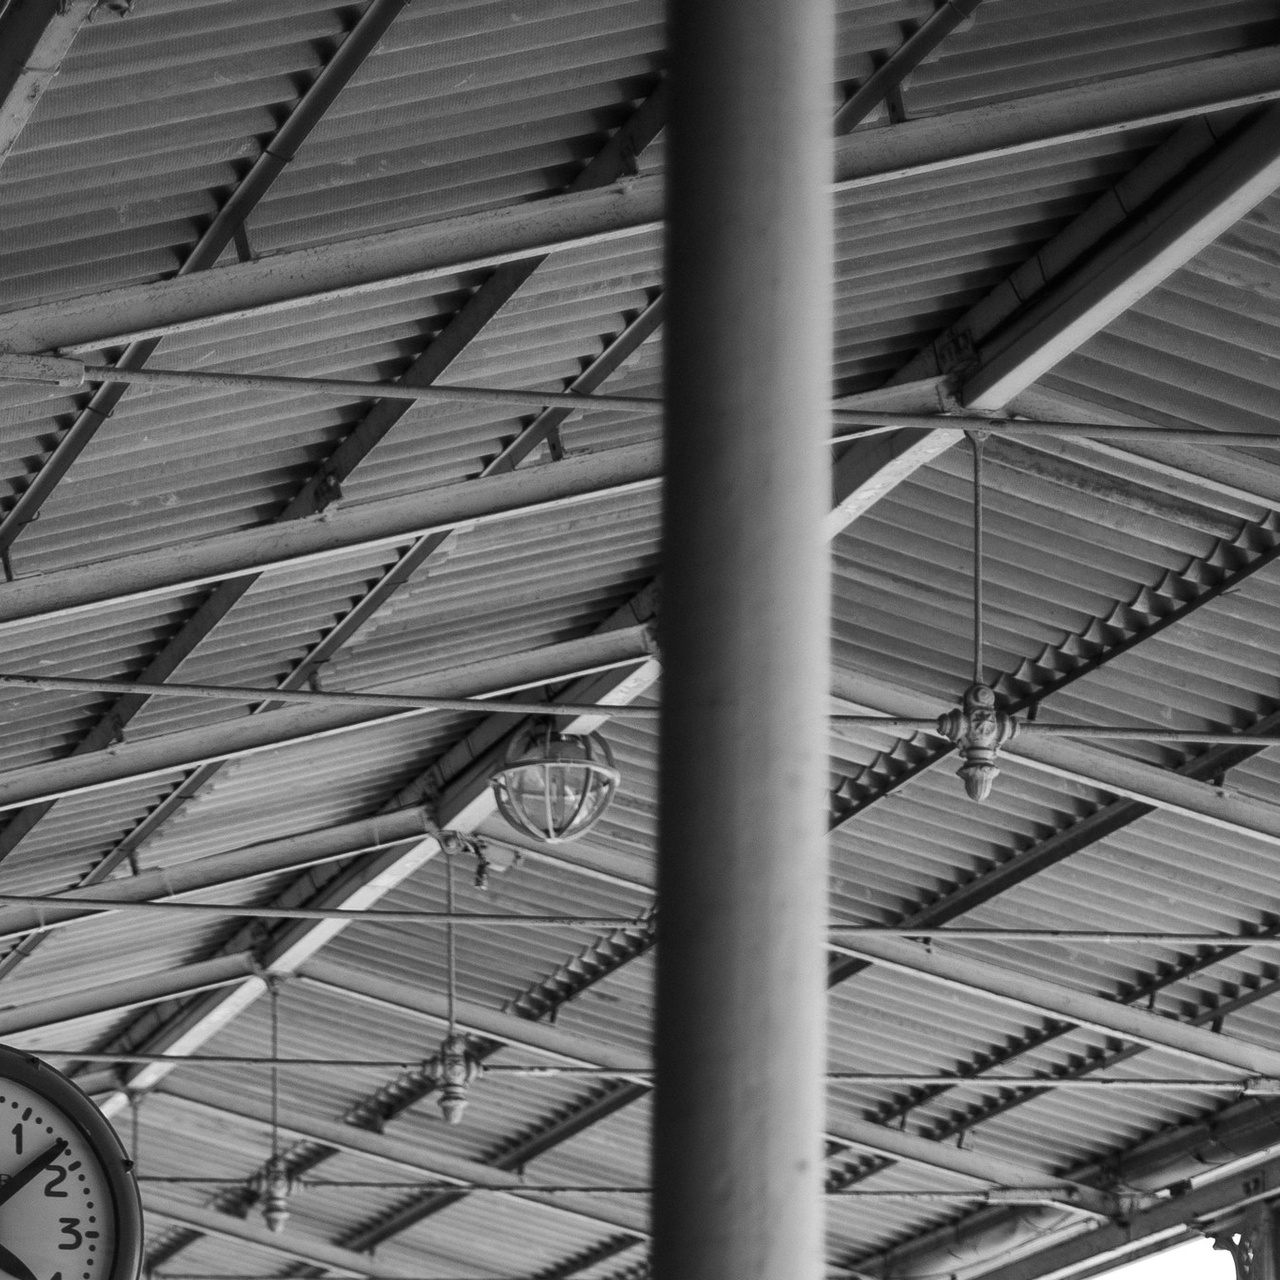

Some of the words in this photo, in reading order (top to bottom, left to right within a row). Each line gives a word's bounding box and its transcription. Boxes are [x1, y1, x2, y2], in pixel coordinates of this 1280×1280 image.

[11, 1122, 23, 1155] 1
[43, 1164, 69, 1198] 2
[58, 1217, 83, 1250] 3
